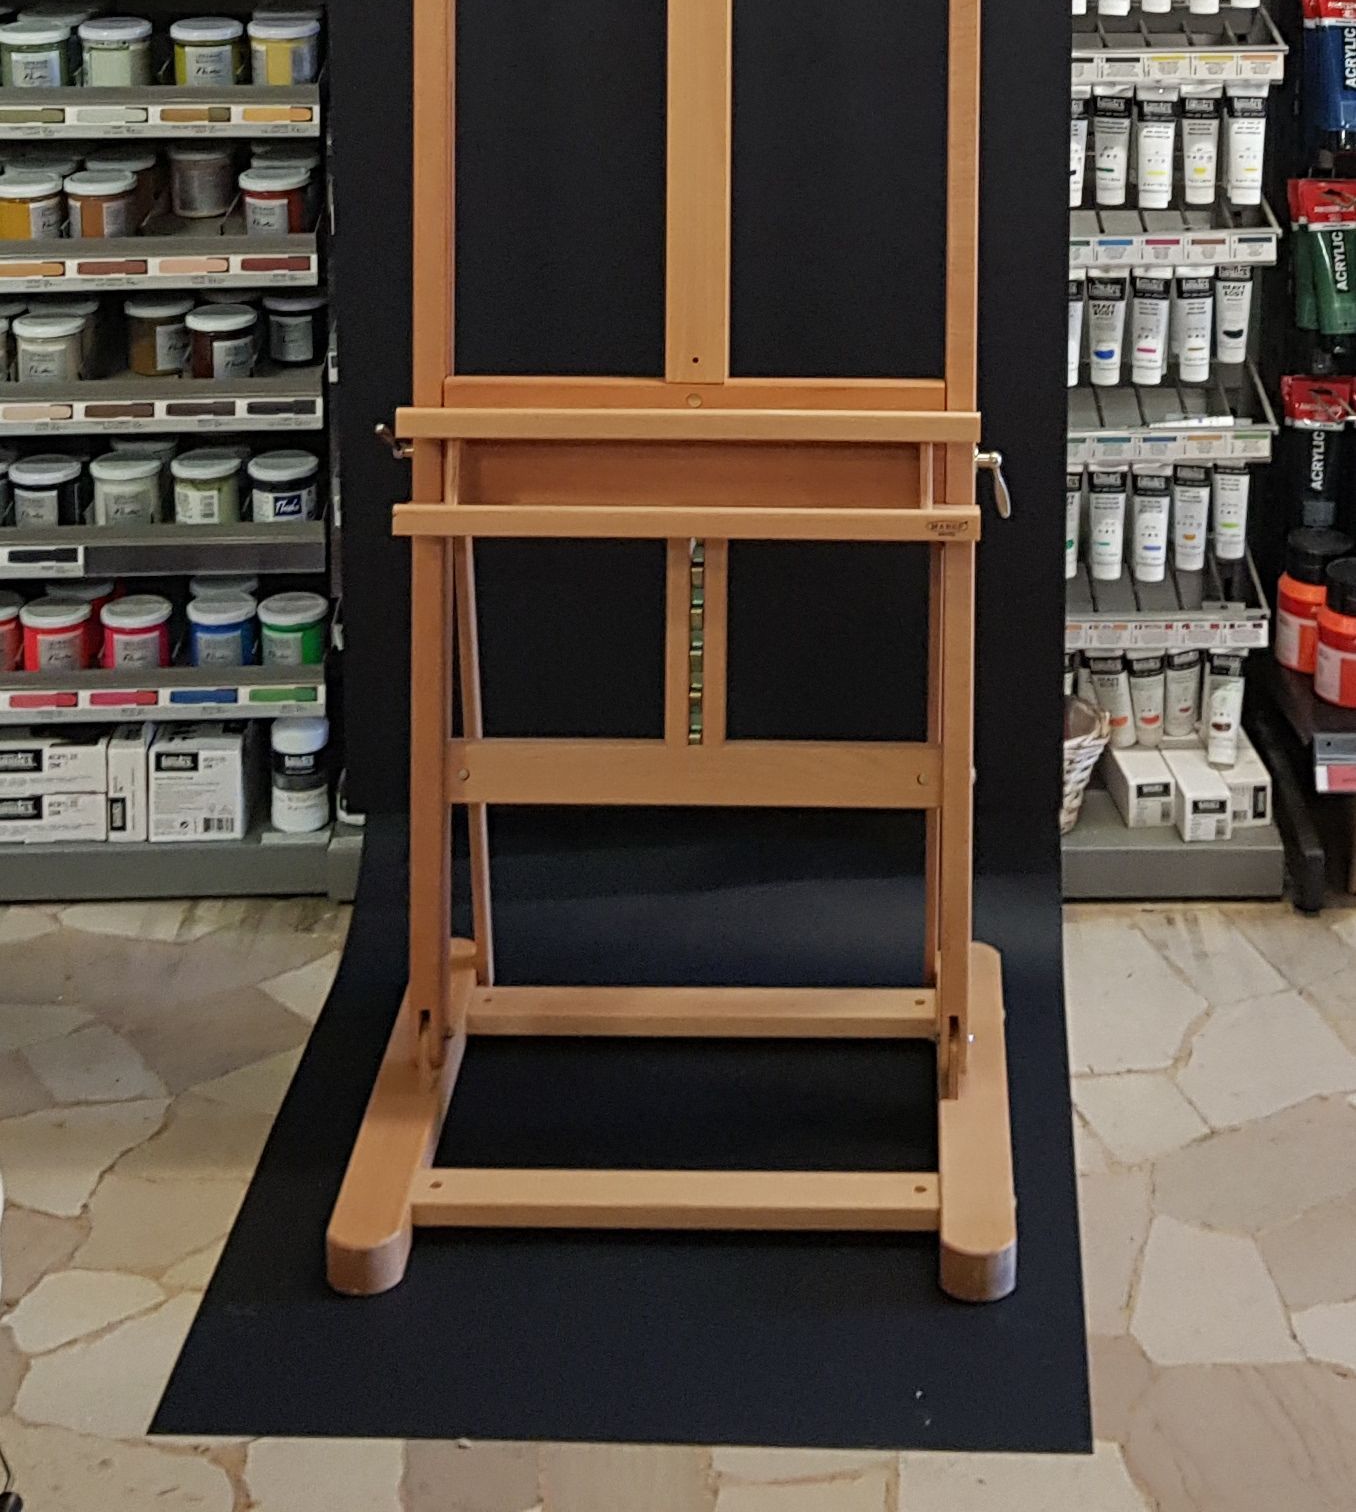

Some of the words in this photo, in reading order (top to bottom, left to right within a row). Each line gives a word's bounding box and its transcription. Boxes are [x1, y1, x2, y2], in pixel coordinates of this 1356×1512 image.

[1344, 27, 1356, 89] ACRYLIC
[1331, 231, 1348, 291] ACRYLIC
[1310, 431, 1326, 491] ACRYLIC
